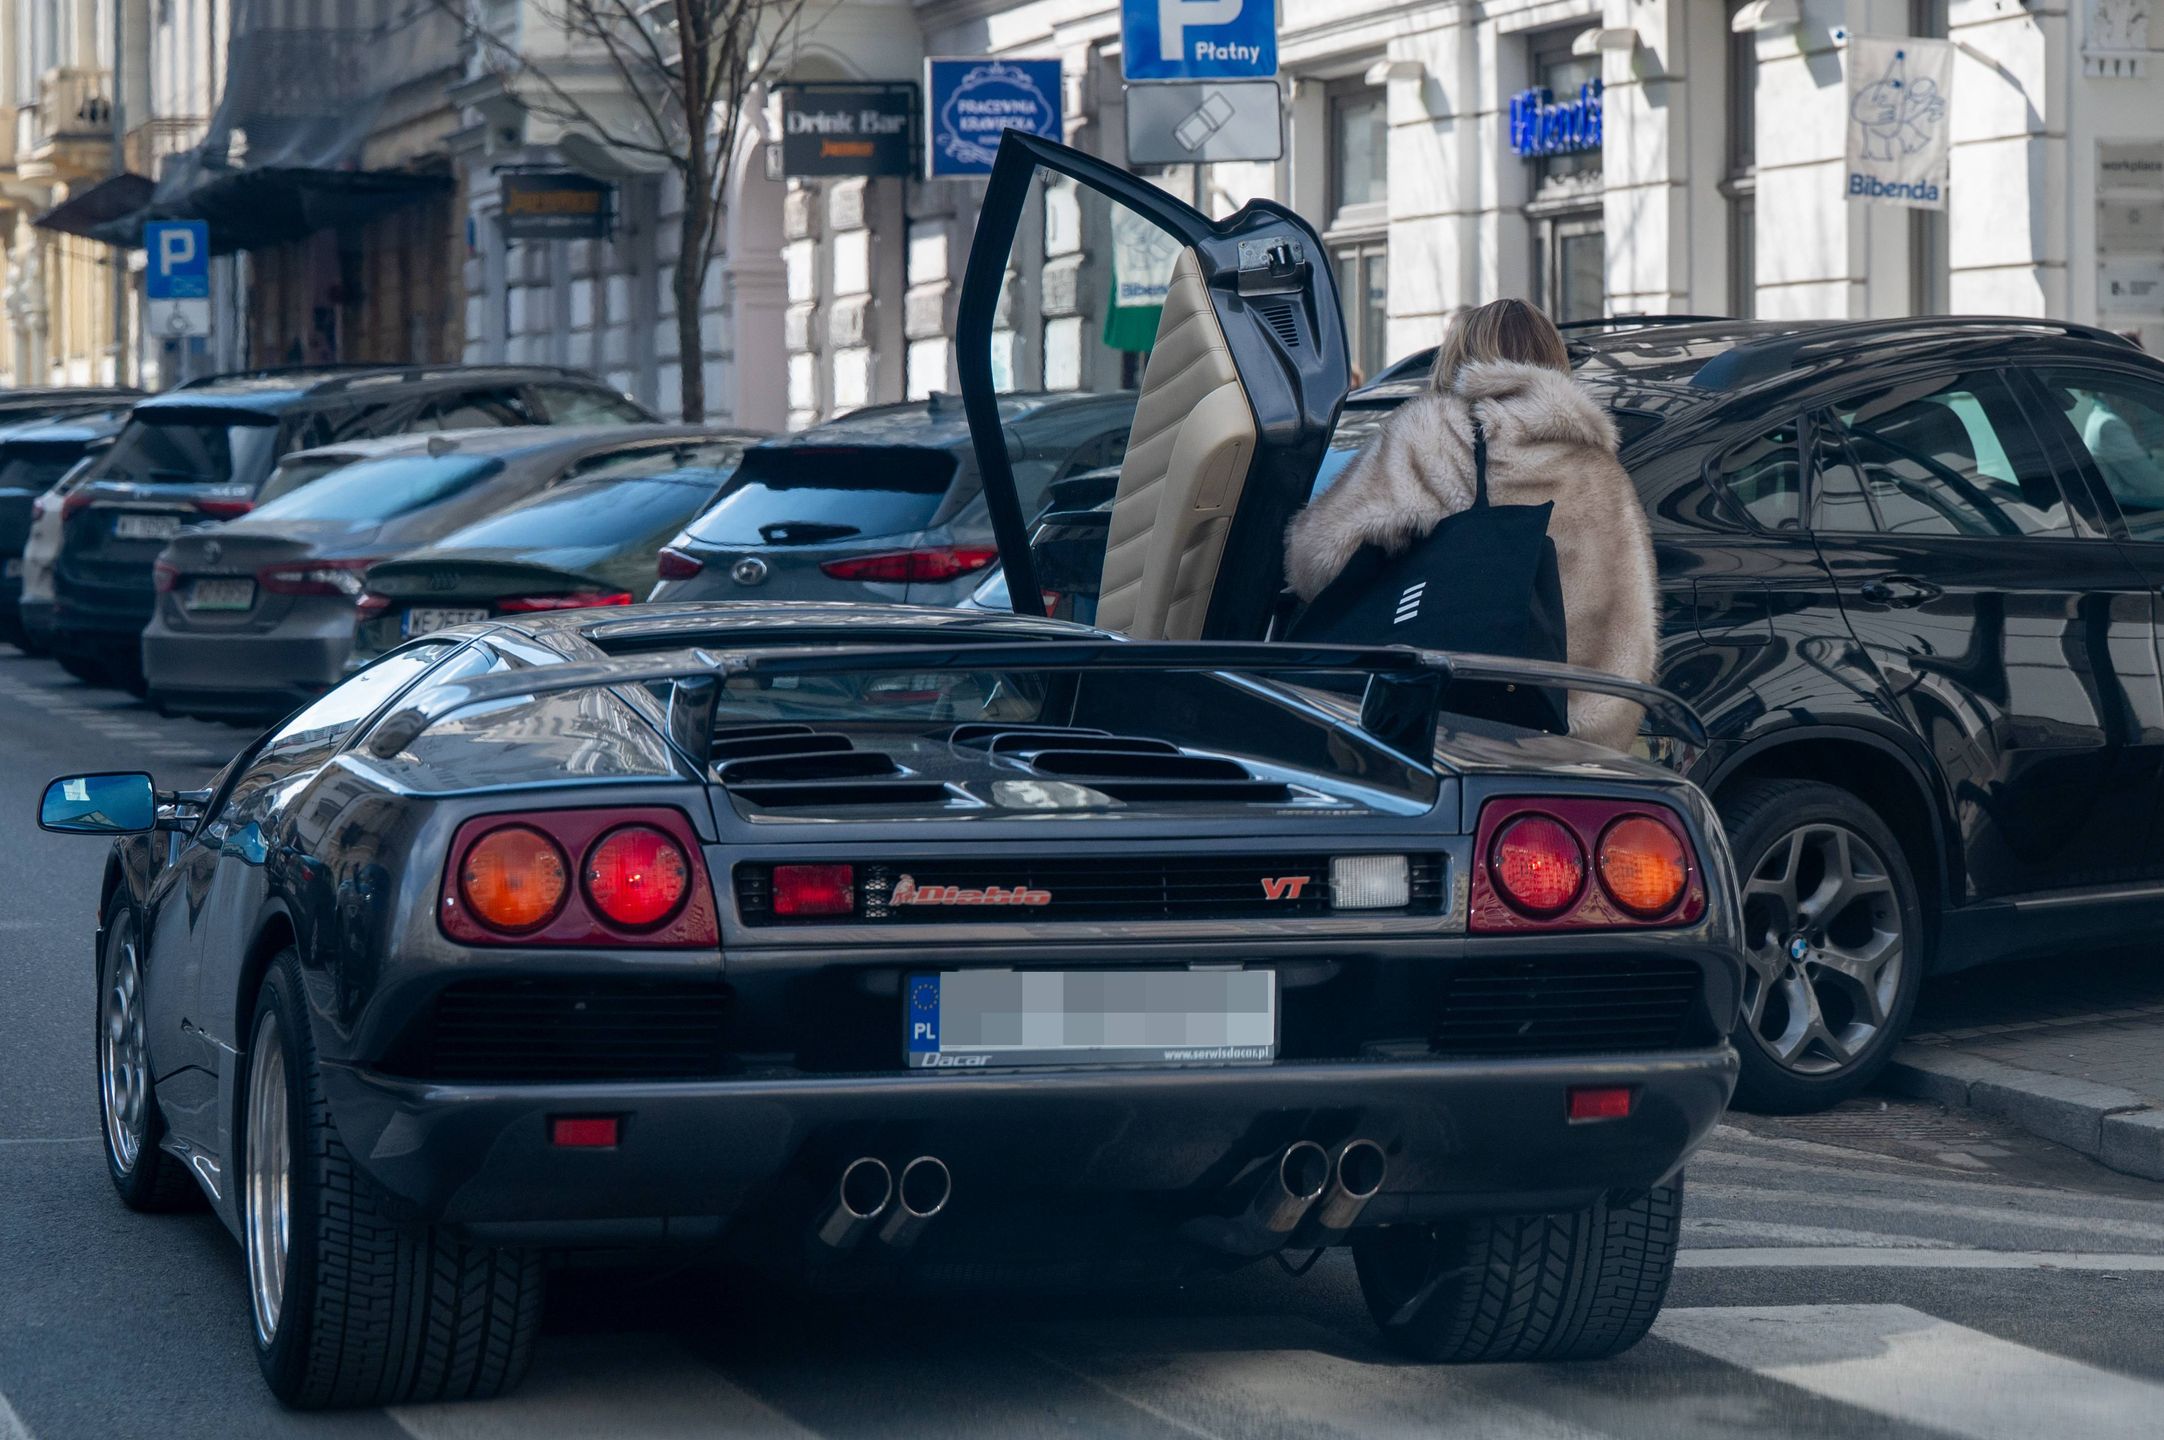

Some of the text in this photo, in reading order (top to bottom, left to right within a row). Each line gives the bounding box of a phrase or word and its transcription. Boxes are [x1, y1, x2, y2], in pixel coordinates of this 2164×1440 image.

[1194, 41, 1260, 65] Płatny
[787, 110, 907, 134] Drink Bar
[1848, 174, 1939, 201] Bibenda
[160, 229, 195, 276] P
[913, 886, 1052, 906] Diablo
[1261, 876, 1311, 900] VT
[914, 1022, 936, 1040] PL
[921, 1052, 992, 1068] Dacar
[1164, 1045, 1269, 1060] www.serwisdacar.pl
